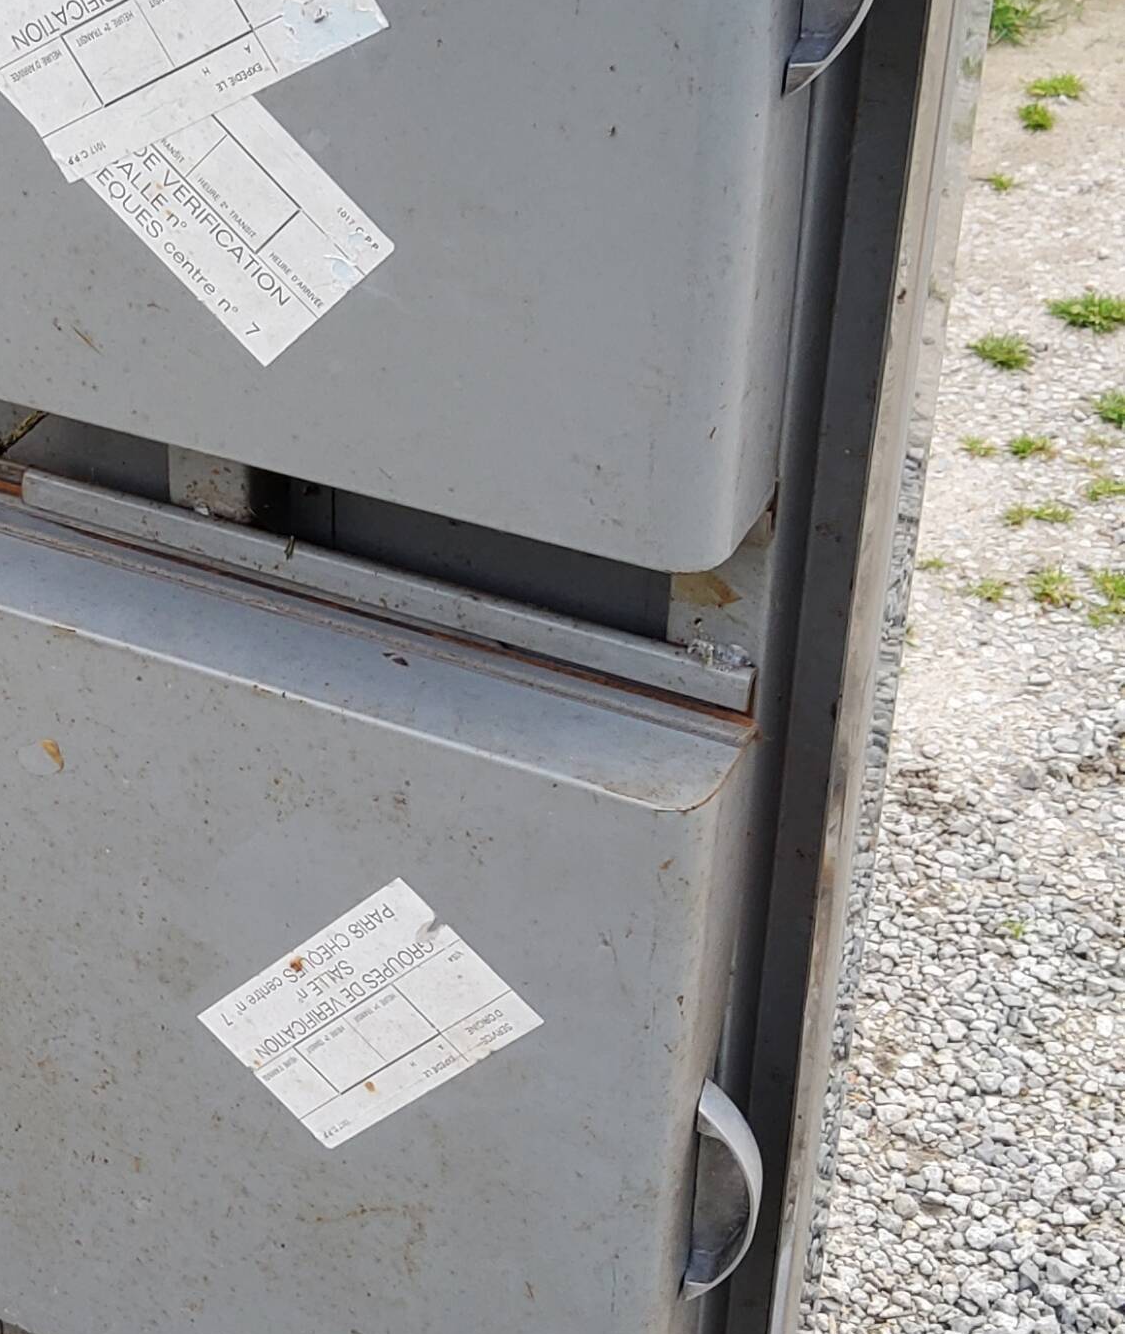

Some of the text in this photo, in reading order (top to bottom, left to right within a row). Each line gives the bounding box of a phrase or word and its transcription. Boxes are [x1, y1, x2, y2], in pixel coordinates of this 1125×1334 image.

[111, 10, 134, 28] HEURE
[76, 27, 103, 47] TRANSIT
[41, 49, 62, 66] HEURE
[202, 44, 251, 75] A H
[161, 137, 185, 163] RANSIT
[197, 177, 221, 202] HEURE
[229, 210, 257, 238] TRANSIT
[163, 169, 291, 306] VERIFICATION
[269, 252, 292, 275] HEURE
[164, 242, 215, 295] centre
[245, 321, 261, 335] 7
[348, 903, 395, 939] PARIS
[282, 933, 350, 983] CHEQUES
[362, 935, 434, 989] GROUPES
[246, 976, 283, 1005] centre
[306, 960, 354, 997] SALLE
[339, 981, 366, 1004] DE
[220, 1013, 234, 1026] 7
[255, 997, 346, 1059] VERIFICATION
